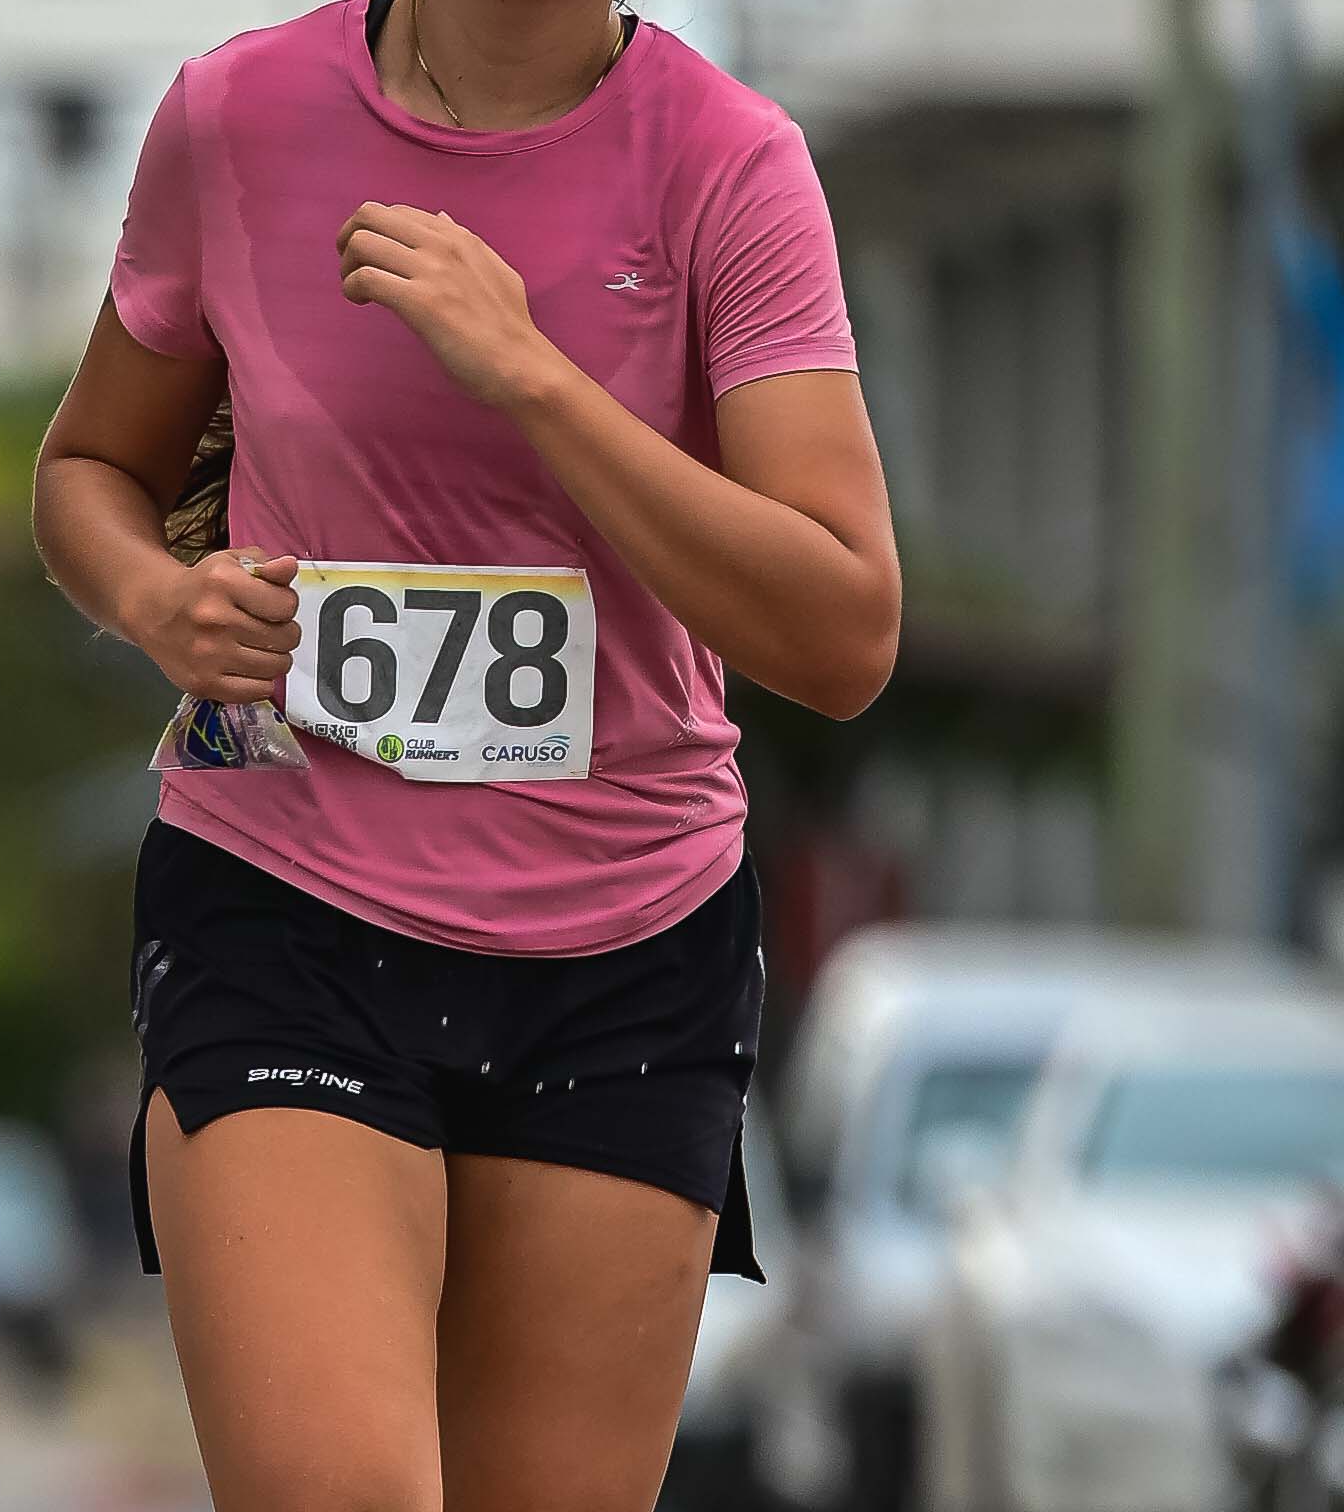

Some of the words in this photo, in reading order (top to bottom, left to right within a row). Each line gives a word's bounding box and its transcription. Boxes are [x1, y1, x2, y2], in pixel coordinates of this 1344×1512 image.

[316, 586, 569, 727] 678
[406, 738, 435, 749] CLUB
[481, 745, 568, 762] CARUSO
